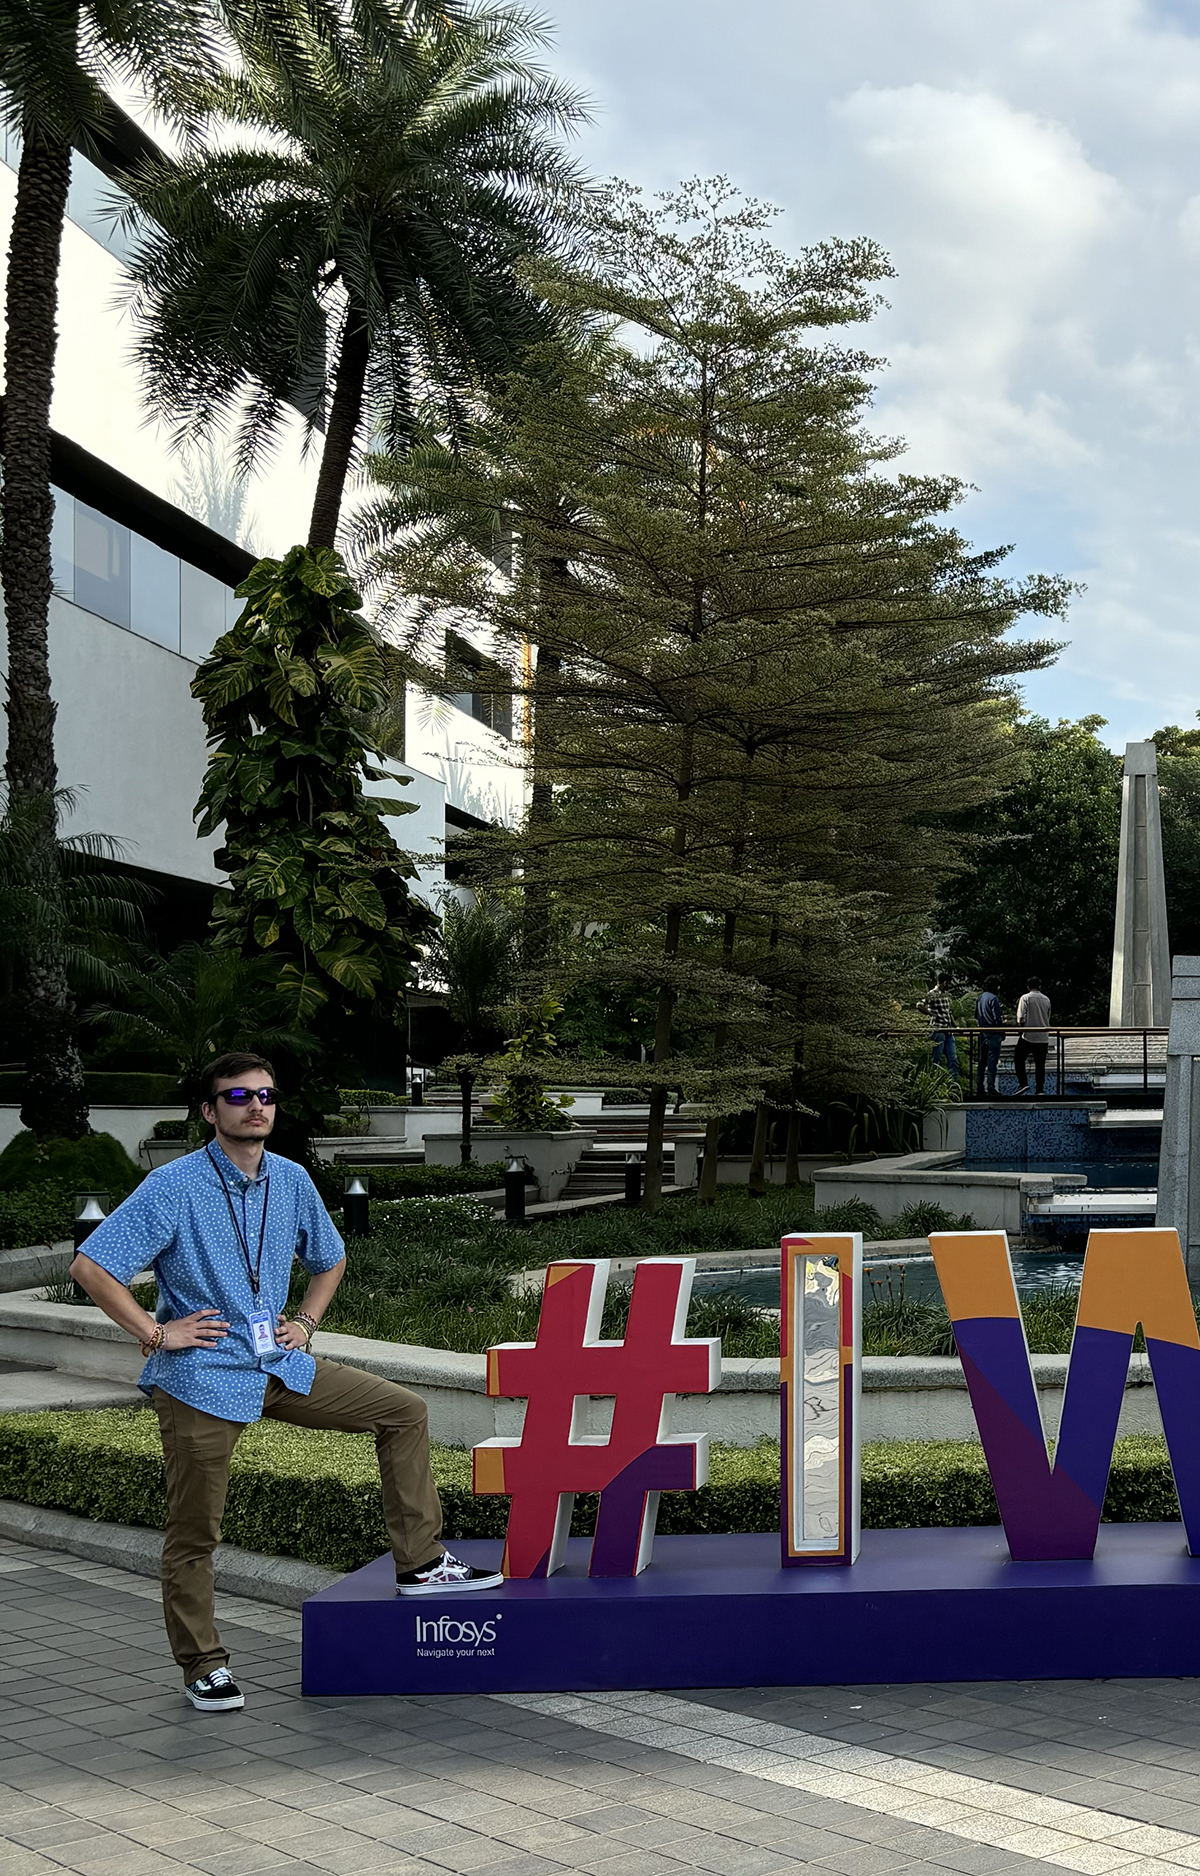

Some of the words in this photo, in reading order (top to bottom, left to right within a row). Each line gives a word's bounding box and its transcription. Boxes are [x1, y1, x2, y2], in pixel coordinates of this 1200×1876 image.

[416, 1614, 498, 1647] Infosys
[416, 1648, 454, 1659] Navigate
[456, 1649, 475, 1658] your
[476, 1648, 496, 1657] next
